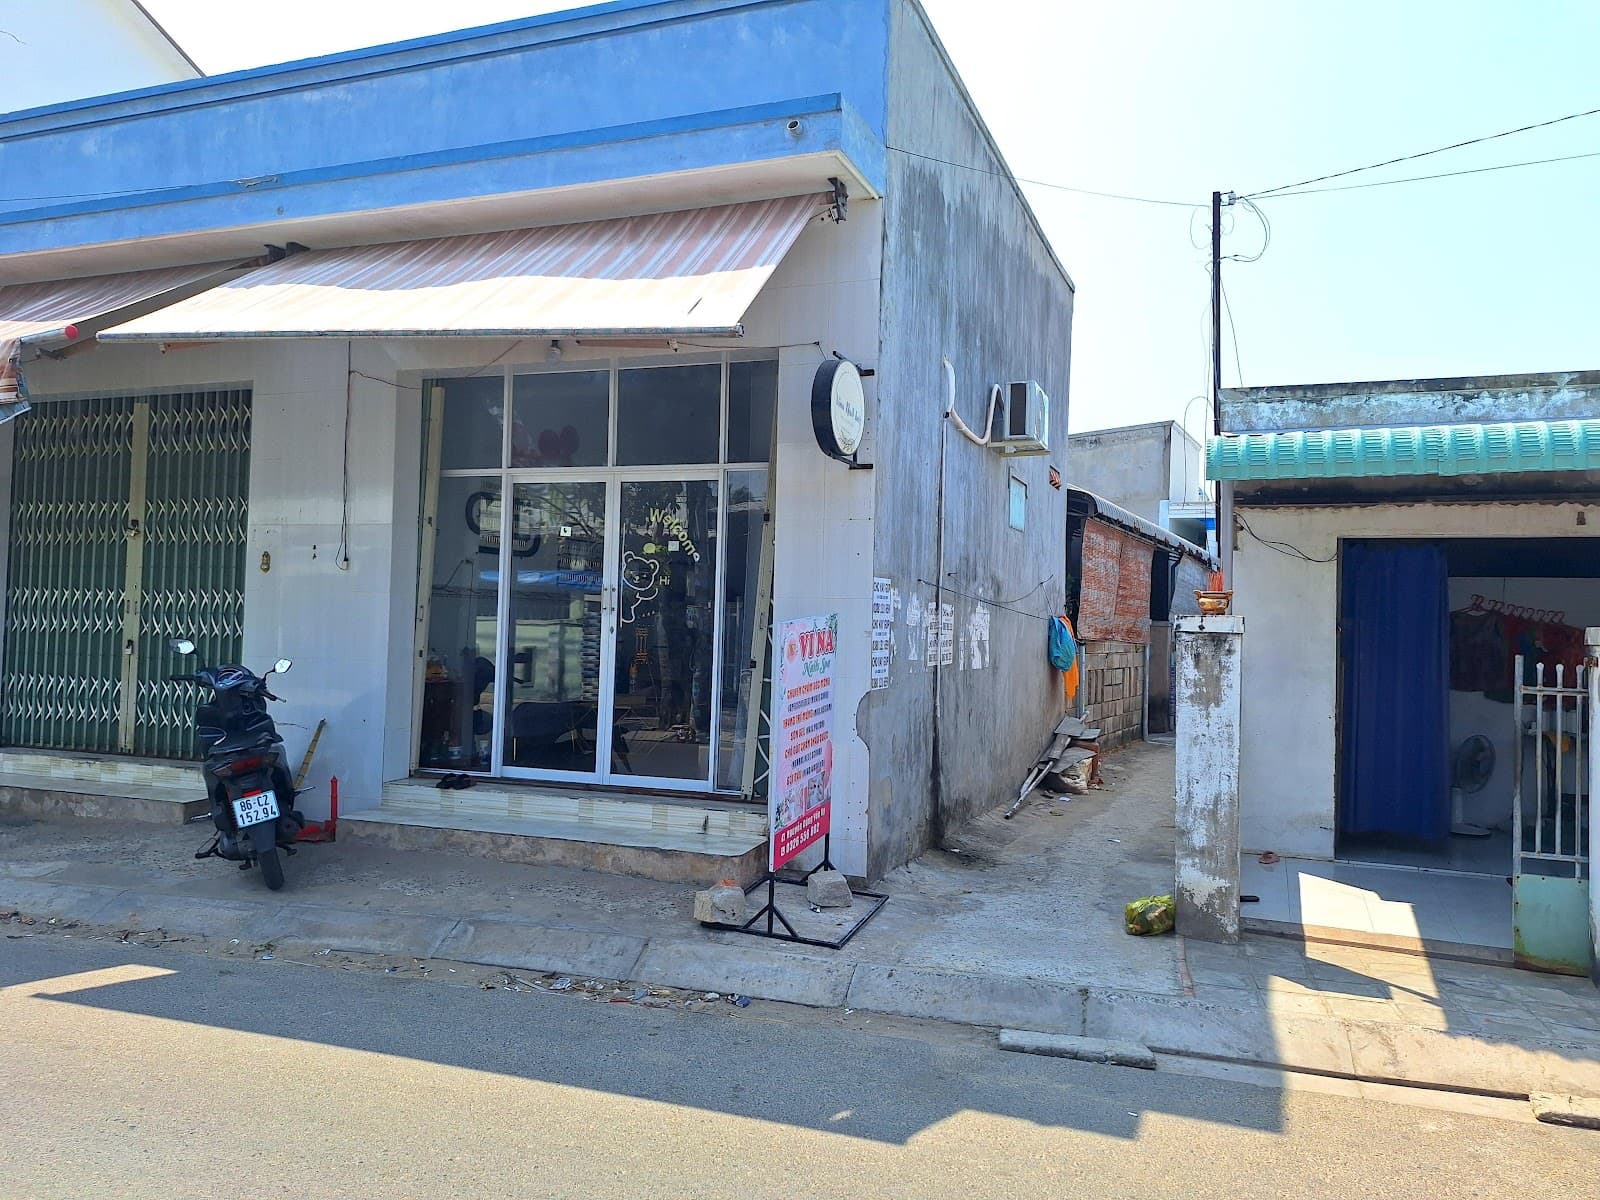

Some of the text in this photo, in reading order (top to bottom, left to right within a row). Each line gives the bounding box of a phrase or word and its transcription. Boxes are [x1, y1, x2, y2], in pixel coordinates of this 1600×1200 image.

[649, 507, 700, 562] Welcome
[659, 575, 670, 585] Hi
[239, 794, 270, 811] 86-C2
[239, 805, 276, 824] 152.94
